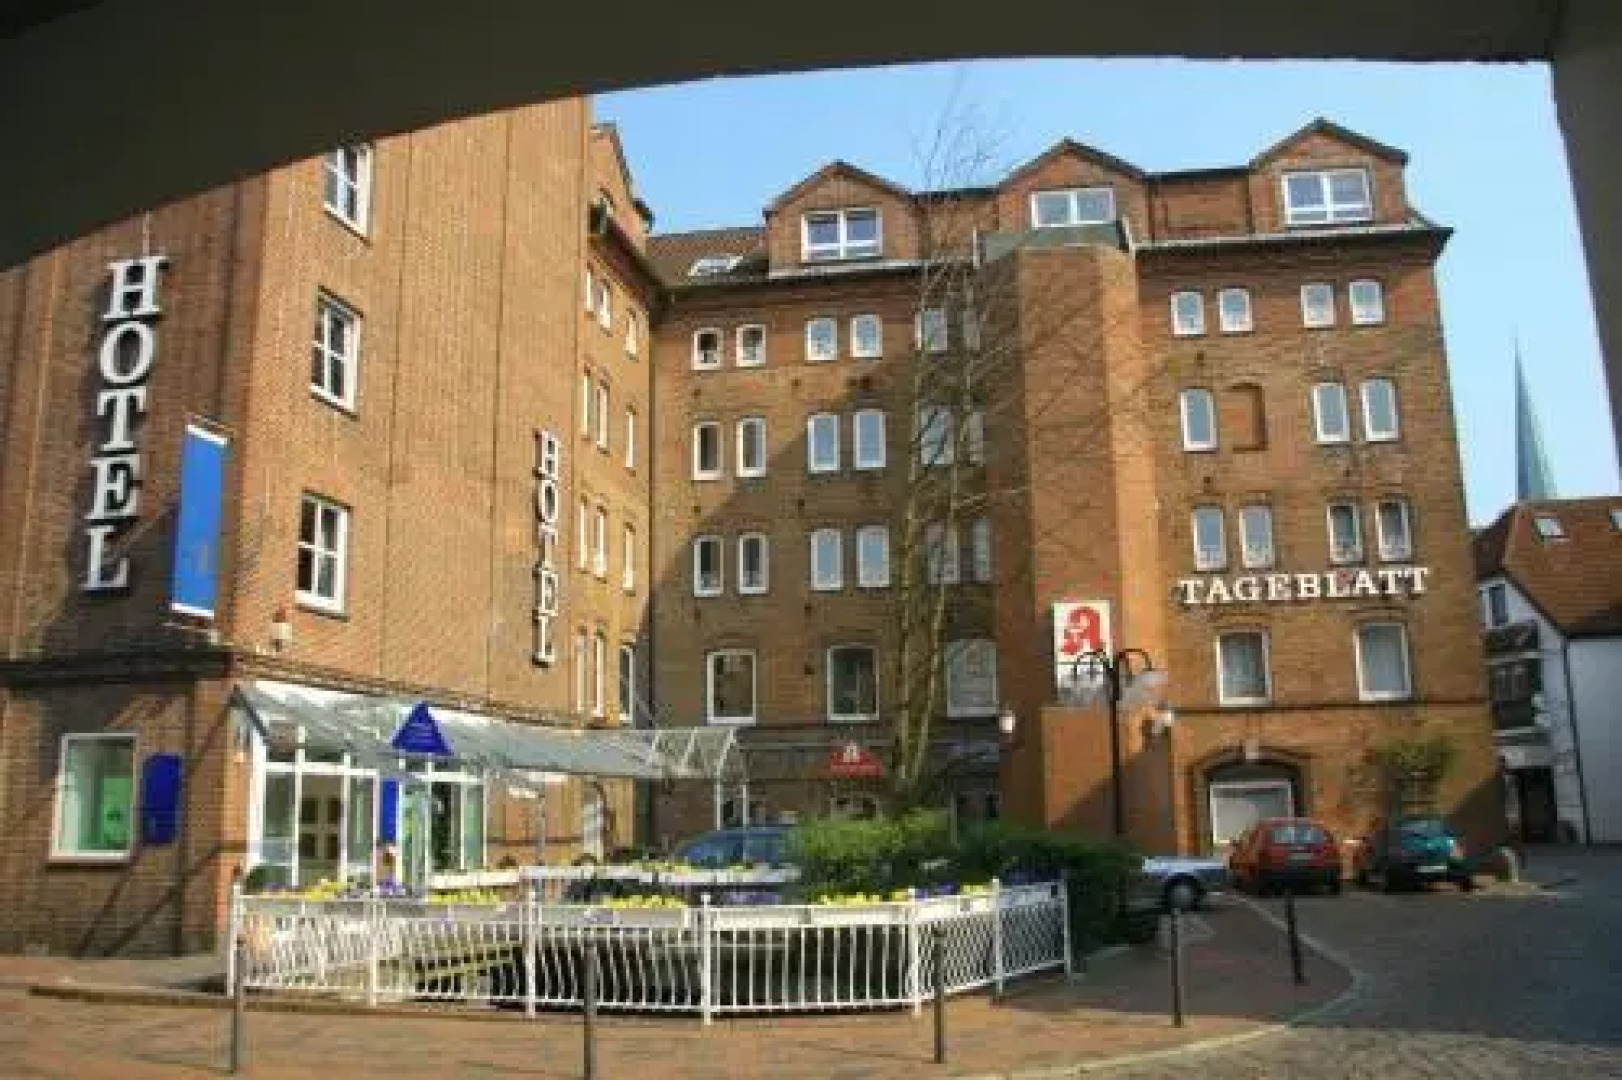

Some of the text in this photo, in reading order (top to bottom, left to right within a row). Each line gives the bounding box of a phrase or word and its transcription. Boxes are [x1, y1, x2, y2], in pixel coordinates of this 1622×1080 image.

[79, 255, 168, 590] HOTEL
[536, 430, 559, 663] HOTEL
[1178, 566, 1431, 604] TAGEBLATT
